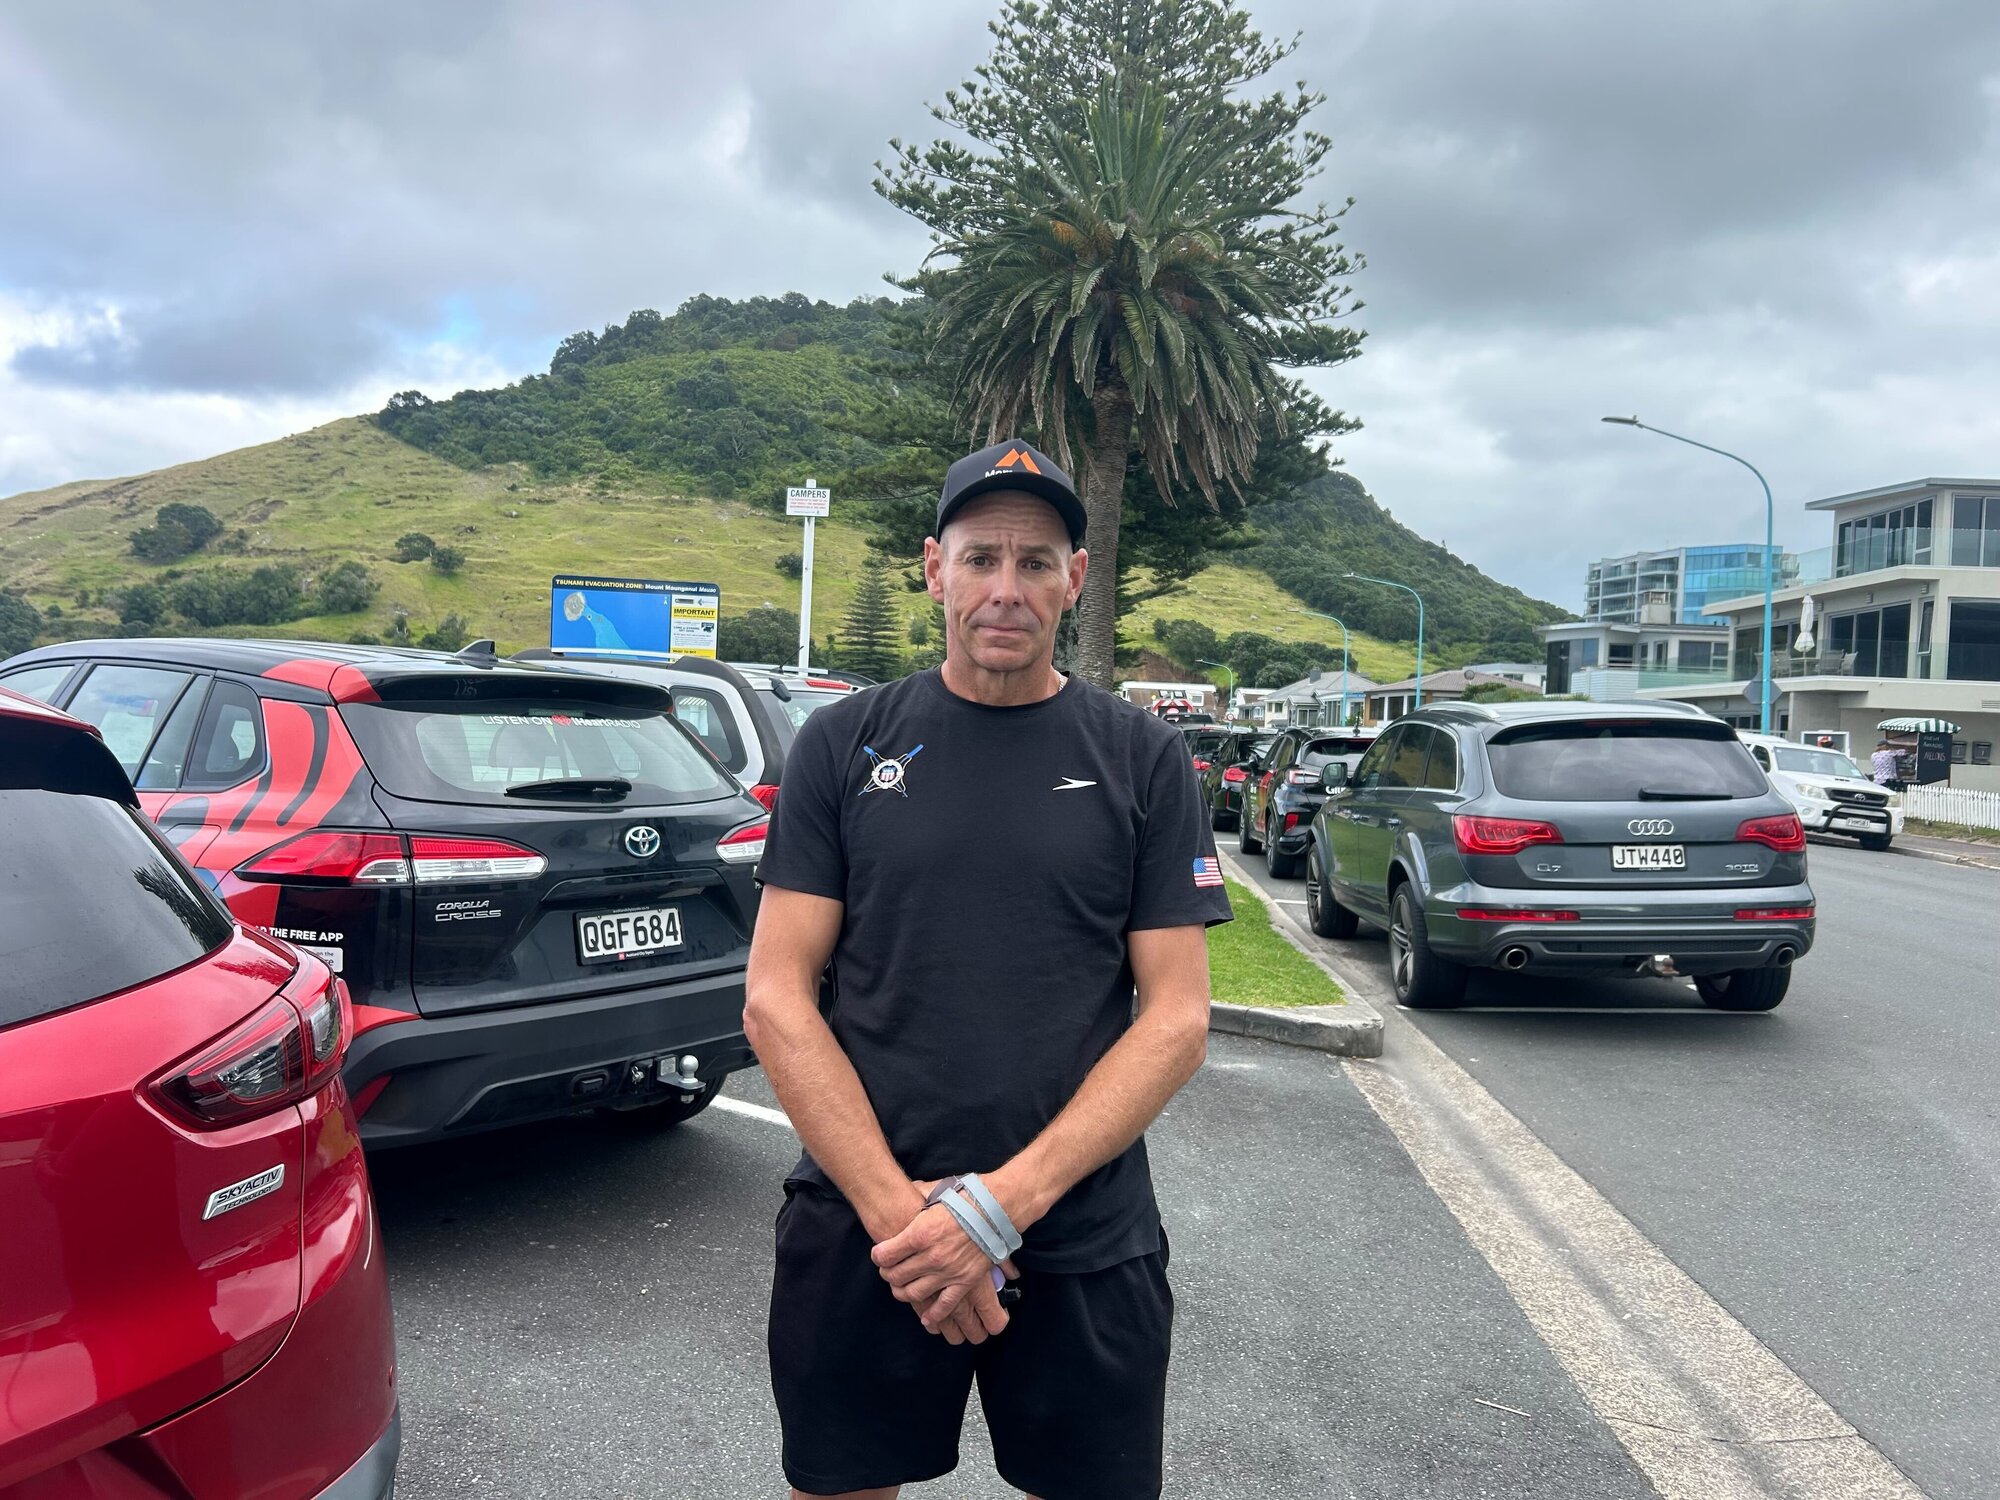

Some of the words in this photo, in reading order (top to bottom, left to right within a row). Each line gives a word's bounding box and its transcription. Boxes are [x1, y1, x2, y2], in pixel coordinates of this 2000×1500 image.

[790, 490, 827, 498] CAMPERS
[585, 580, 624, 588] EVACUATION
[673, 608, 716, 616] IMPORTANT
[481, 715, 529, 725] LISTEN
[531, 716, 553, 726] ON
[1615, 848, 1684, 865] JTW440
[1537, 863, 1561, 872] Q7
[436, 900, 490, 911] COROLLA
[435, 909, 502, 922] CROSS
[269, 927, 289, 938] THE
[289, 929, 317, 941] FREE
[319, 932, 344, 942] APP
[583, 912, 679, 952] QGF684
[217, 1169, 280, 1204] SKYACTIV
[223, 1185, 274, 1211] TECHNOLOGY
